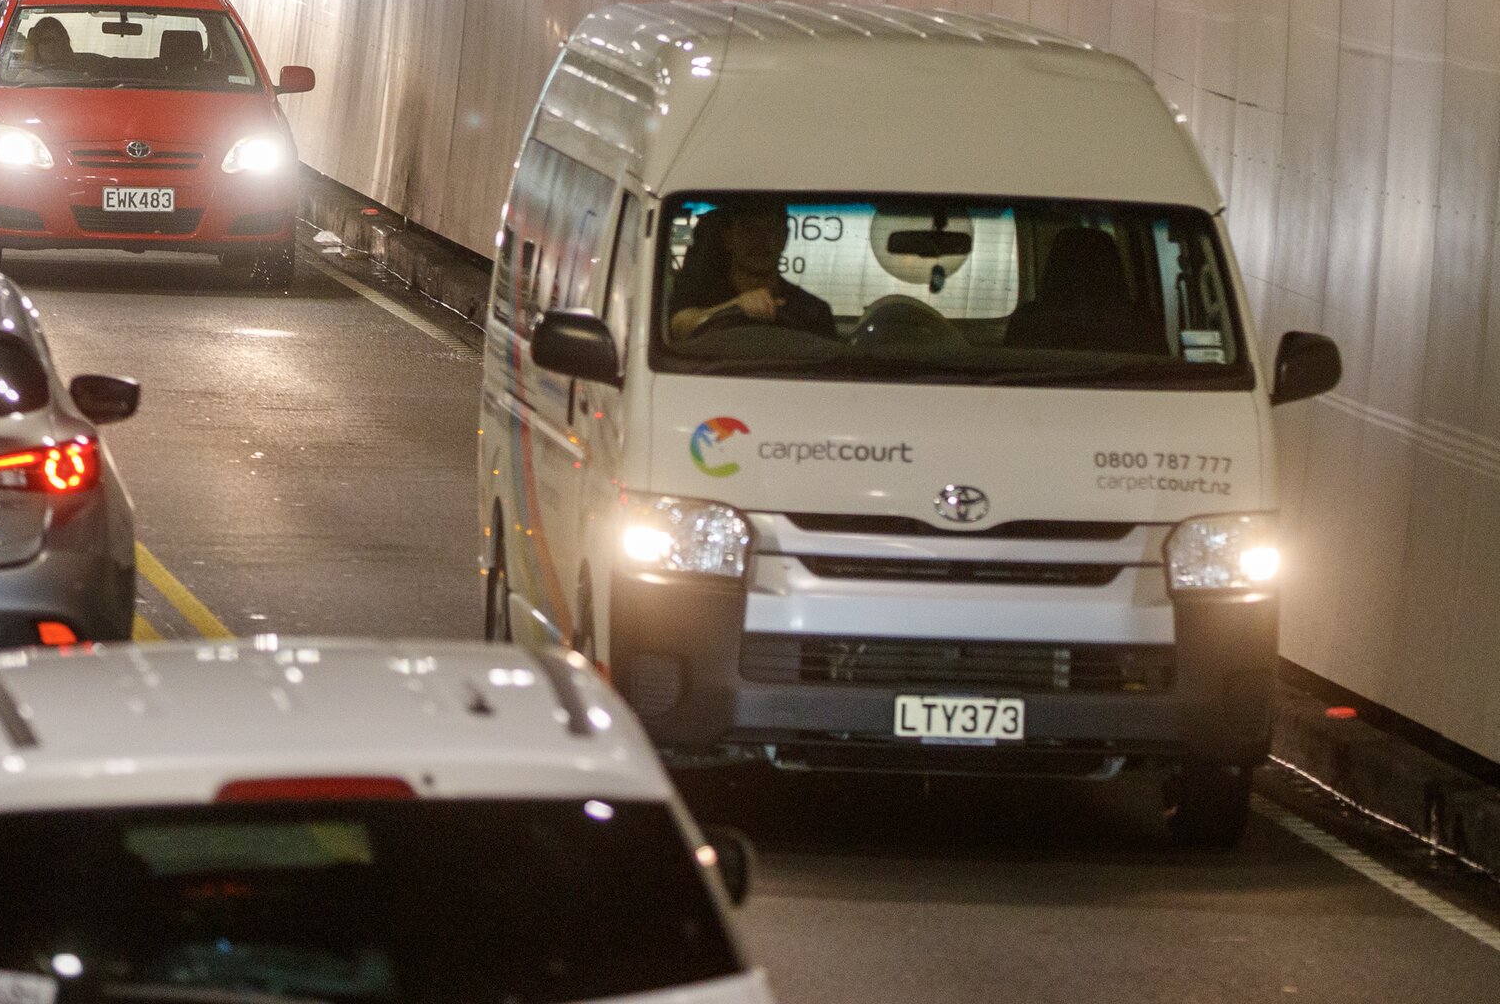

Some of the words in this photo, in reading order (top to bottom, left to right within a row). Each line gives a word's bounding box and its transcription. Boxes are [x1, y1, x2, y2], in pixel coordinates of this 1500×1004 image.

[105, 190, 172, 210] EWK483
[758, 440, 914, 464] carpetcourt
[1094, 452, 1148, 469] 0800
[1154, 453, 1190, 470] 787
[1197, 455, 1232, 474] 777
[1097, 475, 1232, 495] carpetcourt.nz
[901, 703, 1019, 734] LTY373
